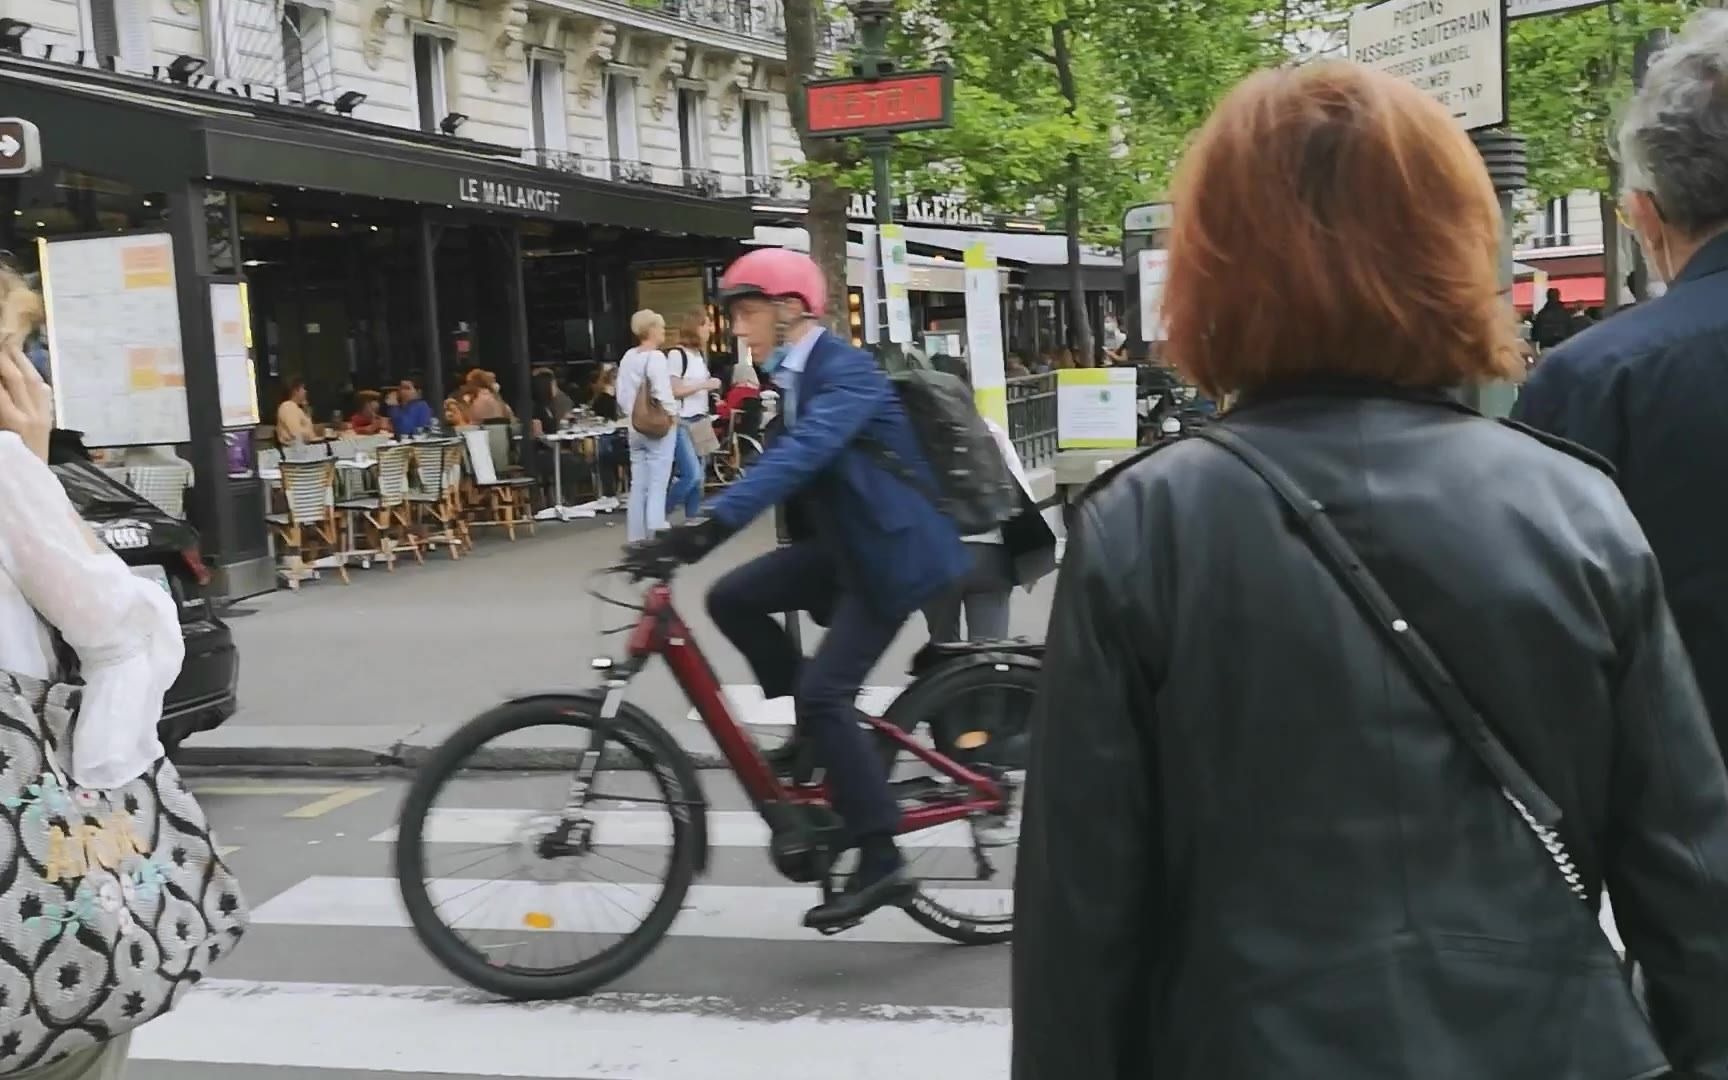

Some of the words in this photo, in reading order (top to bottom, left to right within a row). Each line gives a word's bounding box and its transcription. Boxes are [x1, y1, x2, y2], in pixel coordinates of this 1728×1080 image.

[1355, 34, 1407, 64] PASSAGE
[1411, 8, 1491, 50] SOUTERRAIN
[1429, 45, 1472, 66] MANDEL
[460, 177, 479, 202] LE
[482, 180, 561, 213] MALAKOFF
